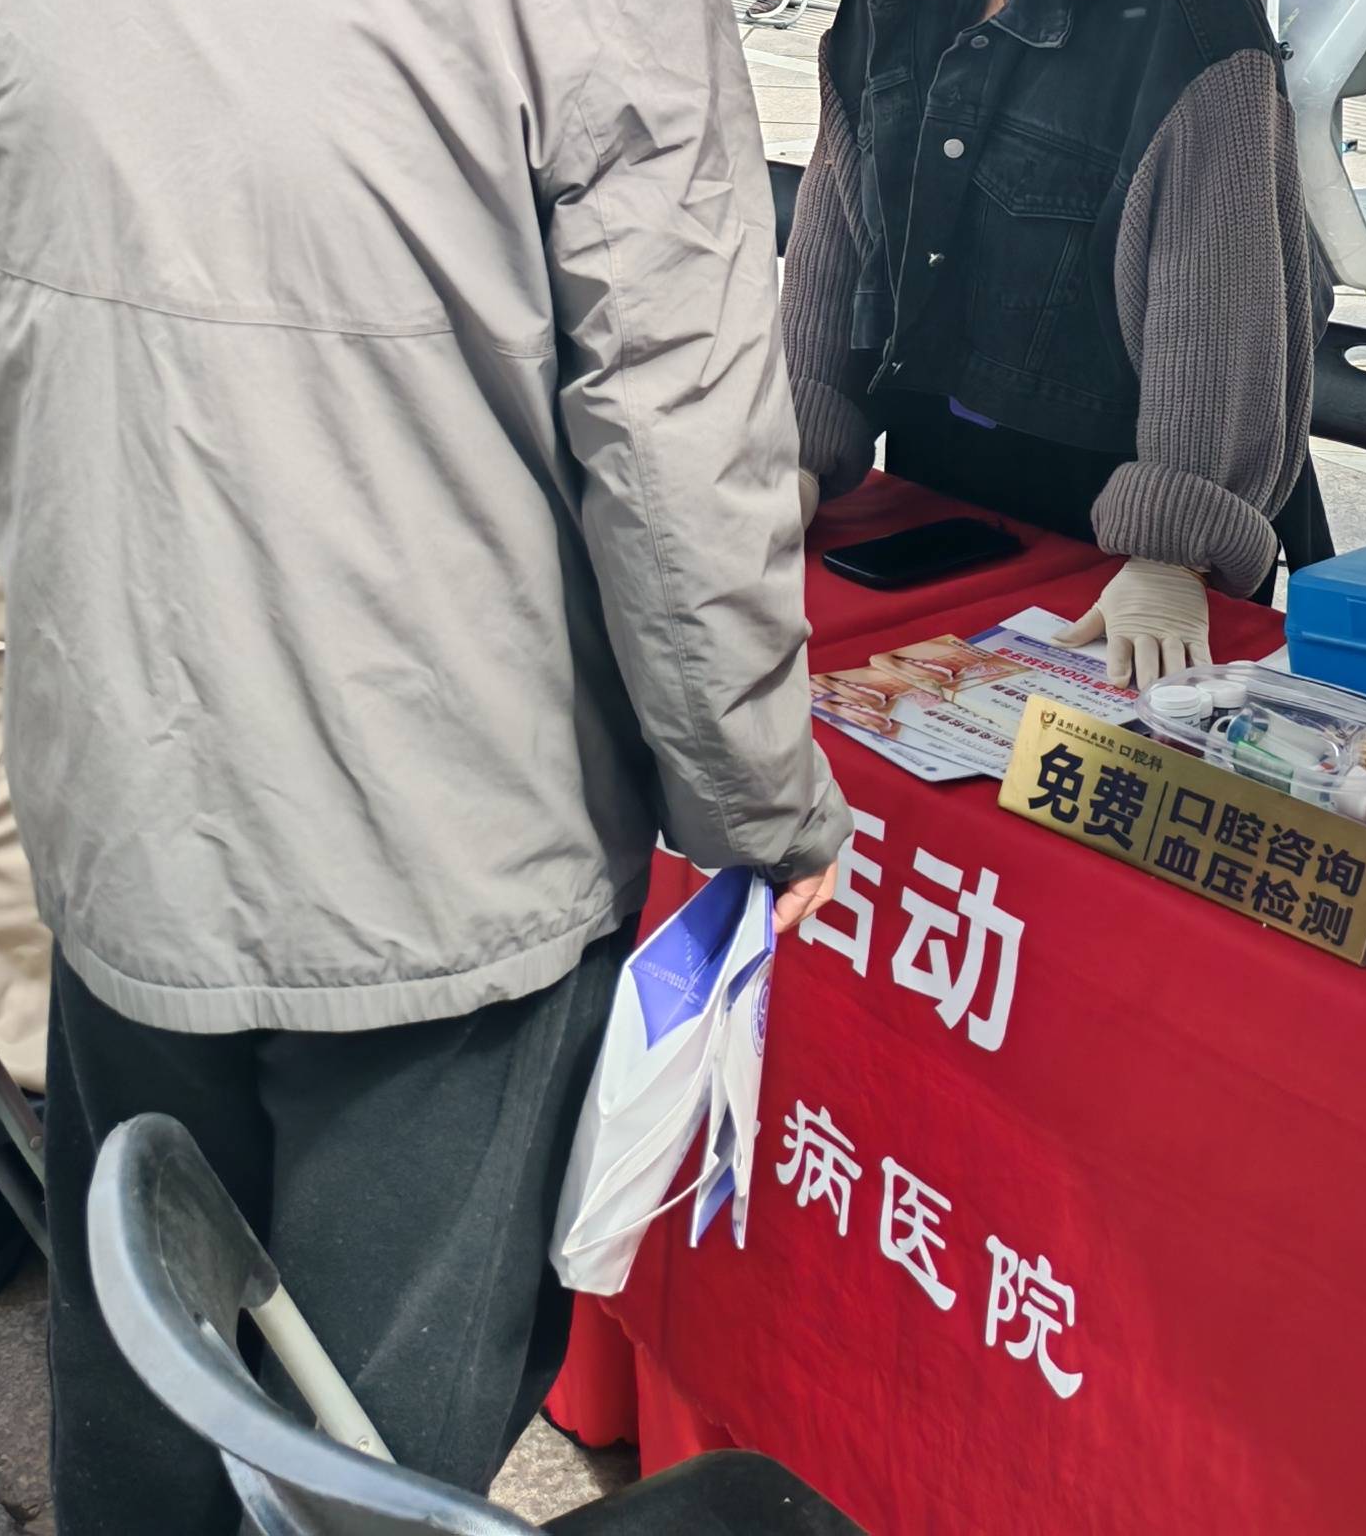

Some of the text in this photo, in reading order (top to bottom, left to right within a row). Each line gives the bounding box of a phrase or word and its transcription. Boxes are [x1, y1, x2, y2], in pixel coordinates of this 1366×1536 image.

[1028, 742, 1148, 851] 免费
[1119, 744, 1164, 773] 口腔科
[1154, 835, 1354, 948] 血压检测
[1168, 786, 1366, 898] 口腔咨询
[775, 1098, 1083, 1399] 病医院
